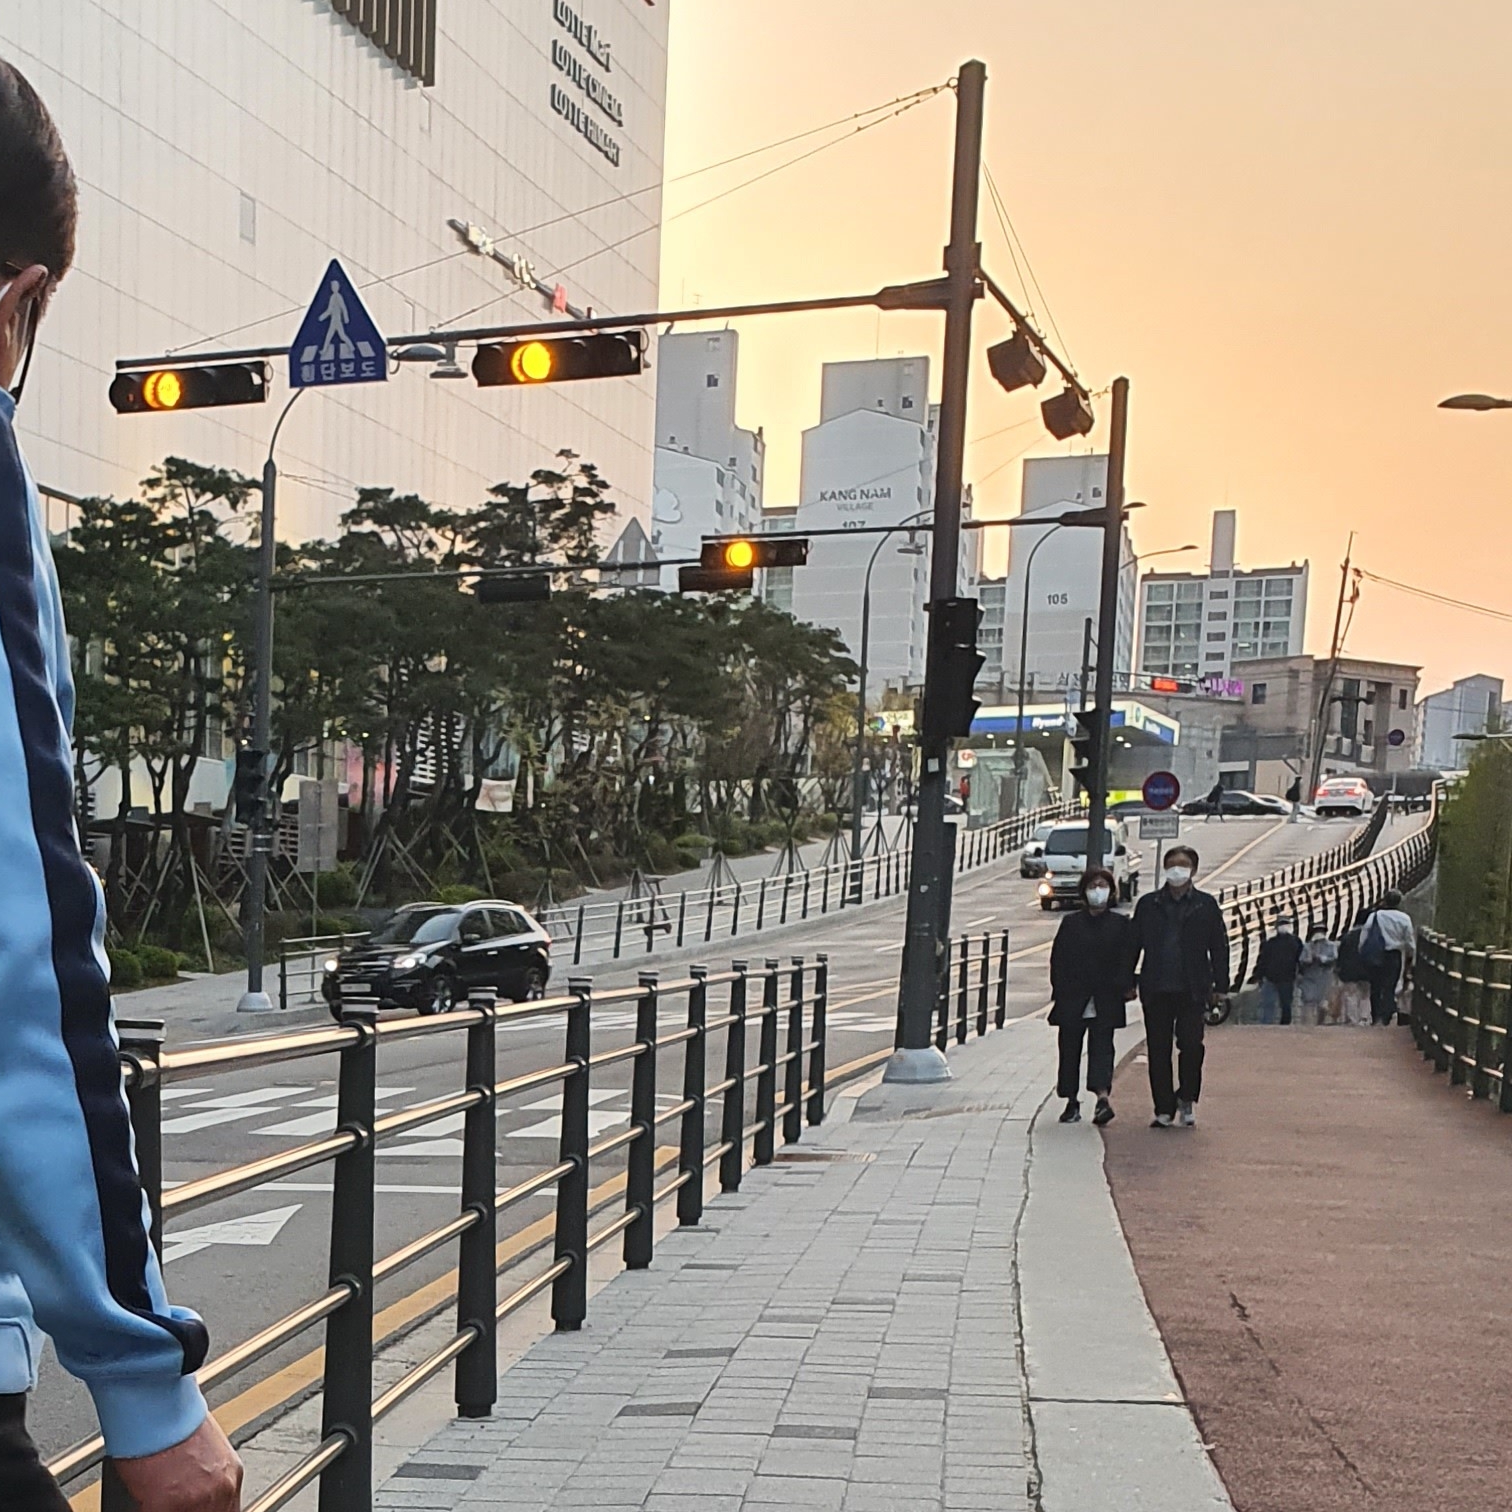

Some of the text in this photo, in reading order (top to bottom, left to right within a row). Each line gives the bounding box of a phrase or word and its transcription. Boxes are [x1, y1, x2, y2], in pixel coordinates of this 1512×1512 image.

[551, 39, 586, 91] LOTTE
[550, 83, 585, 135] LOTTE
[300, 360, 377, 383] 횡단보도
[819, 487, 892, 502] KANG NAM
[1047, 593, 1068, 606] 105
